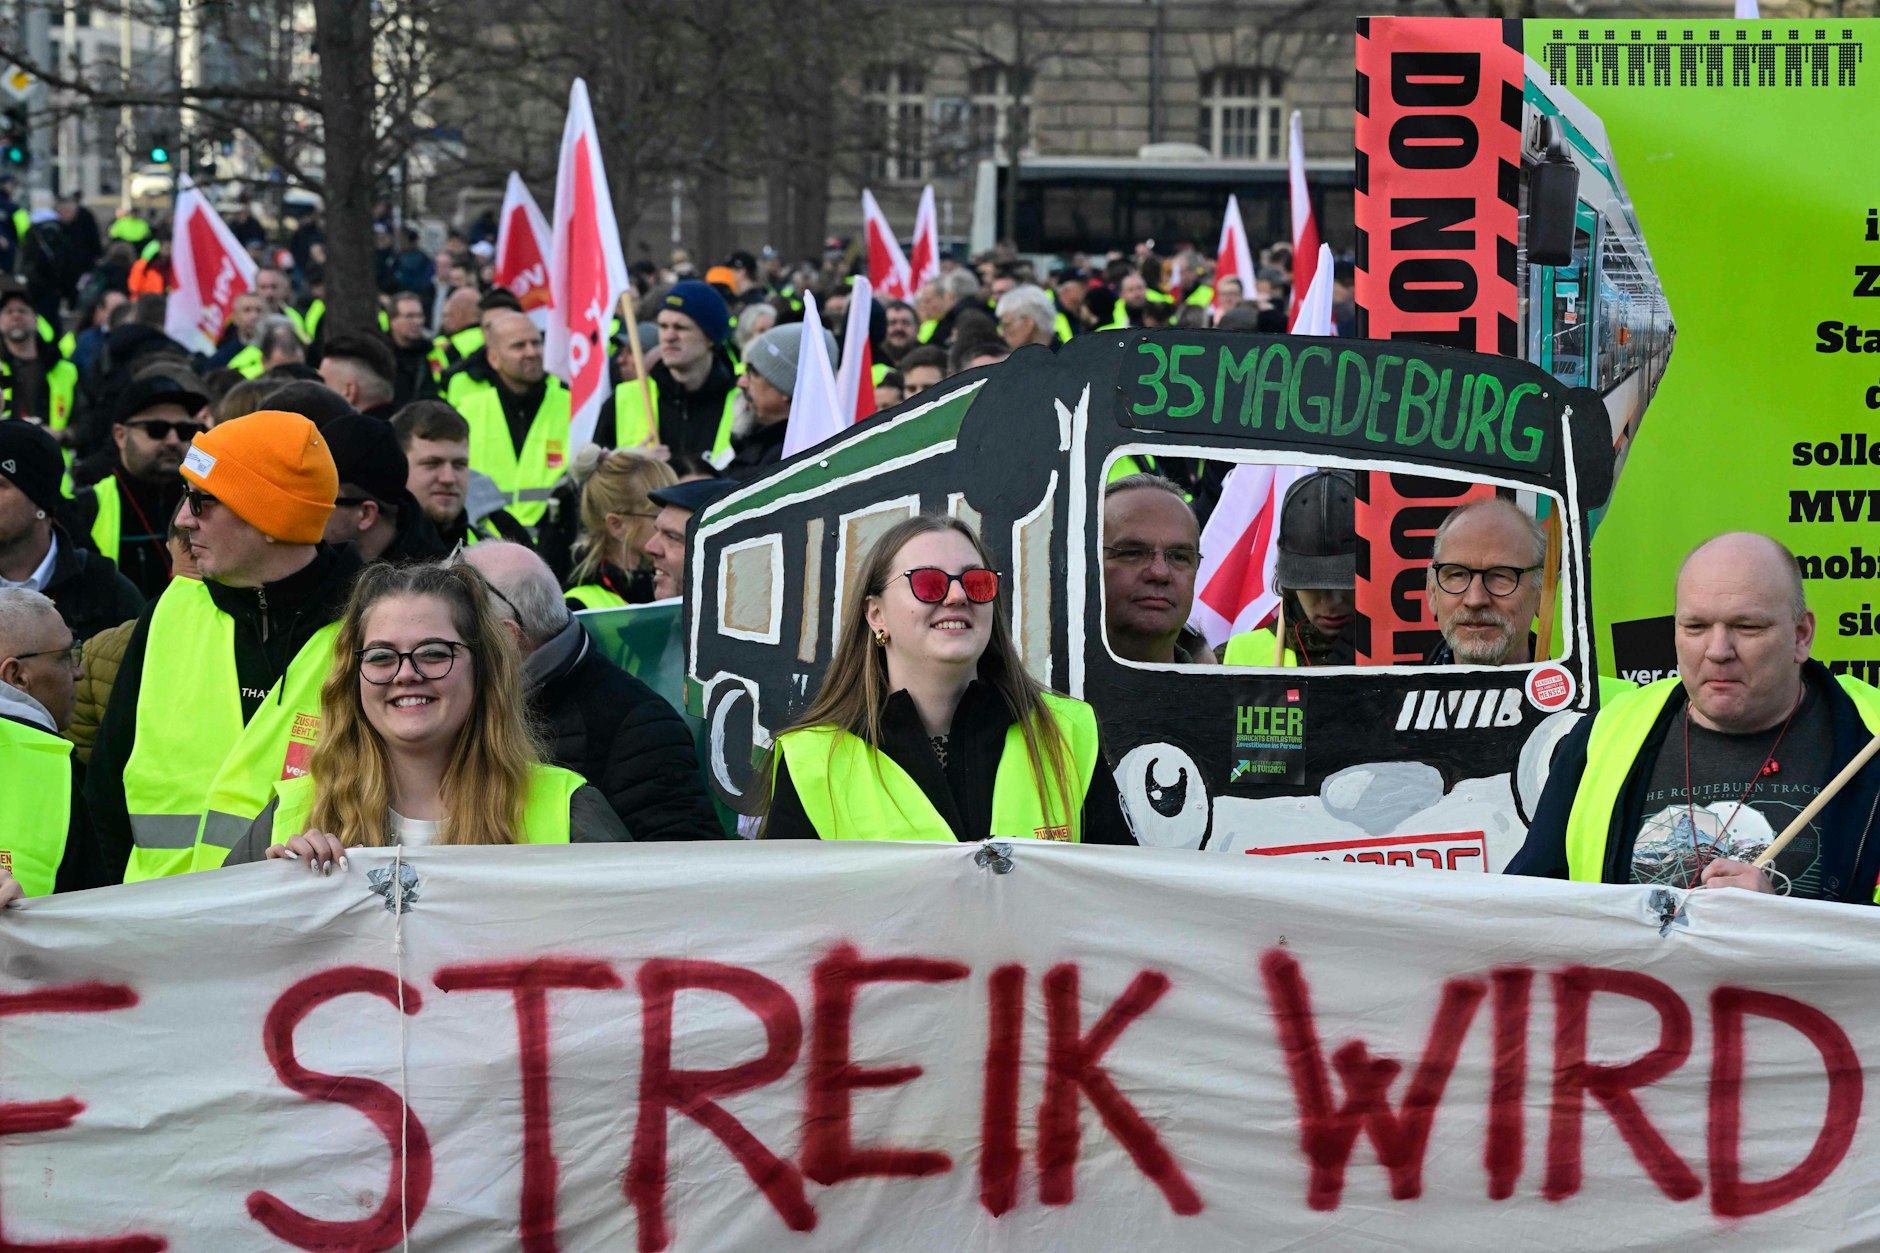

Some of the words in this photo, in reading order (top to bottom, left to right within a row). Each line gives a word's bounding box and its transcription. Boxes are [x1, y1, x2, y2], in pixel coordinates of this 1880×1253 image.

[1389, 51, 1481, 170] DO
[1133, 343, 1206, 418] 35
[1212, 343, 1545, 463] MAGDEBURG
[241, 687, 271, 699] THA
[1539, 686, 1565, 699] MENSCH
[1237, 706, 1303, 735] HIER
[291, 724, 312, 737] GEHT
[1266, 735, 1303, 743] ENTLASTUNG
[1646, 790, 1665, 801] HE
[1671, 782, 1764, 798] ROUTEBURN
[1771, 783, 1822, 796] TRACK
[246, 942, 1204, 1253] STREIK
[1260, 948, 1864, 1218] WIRD
